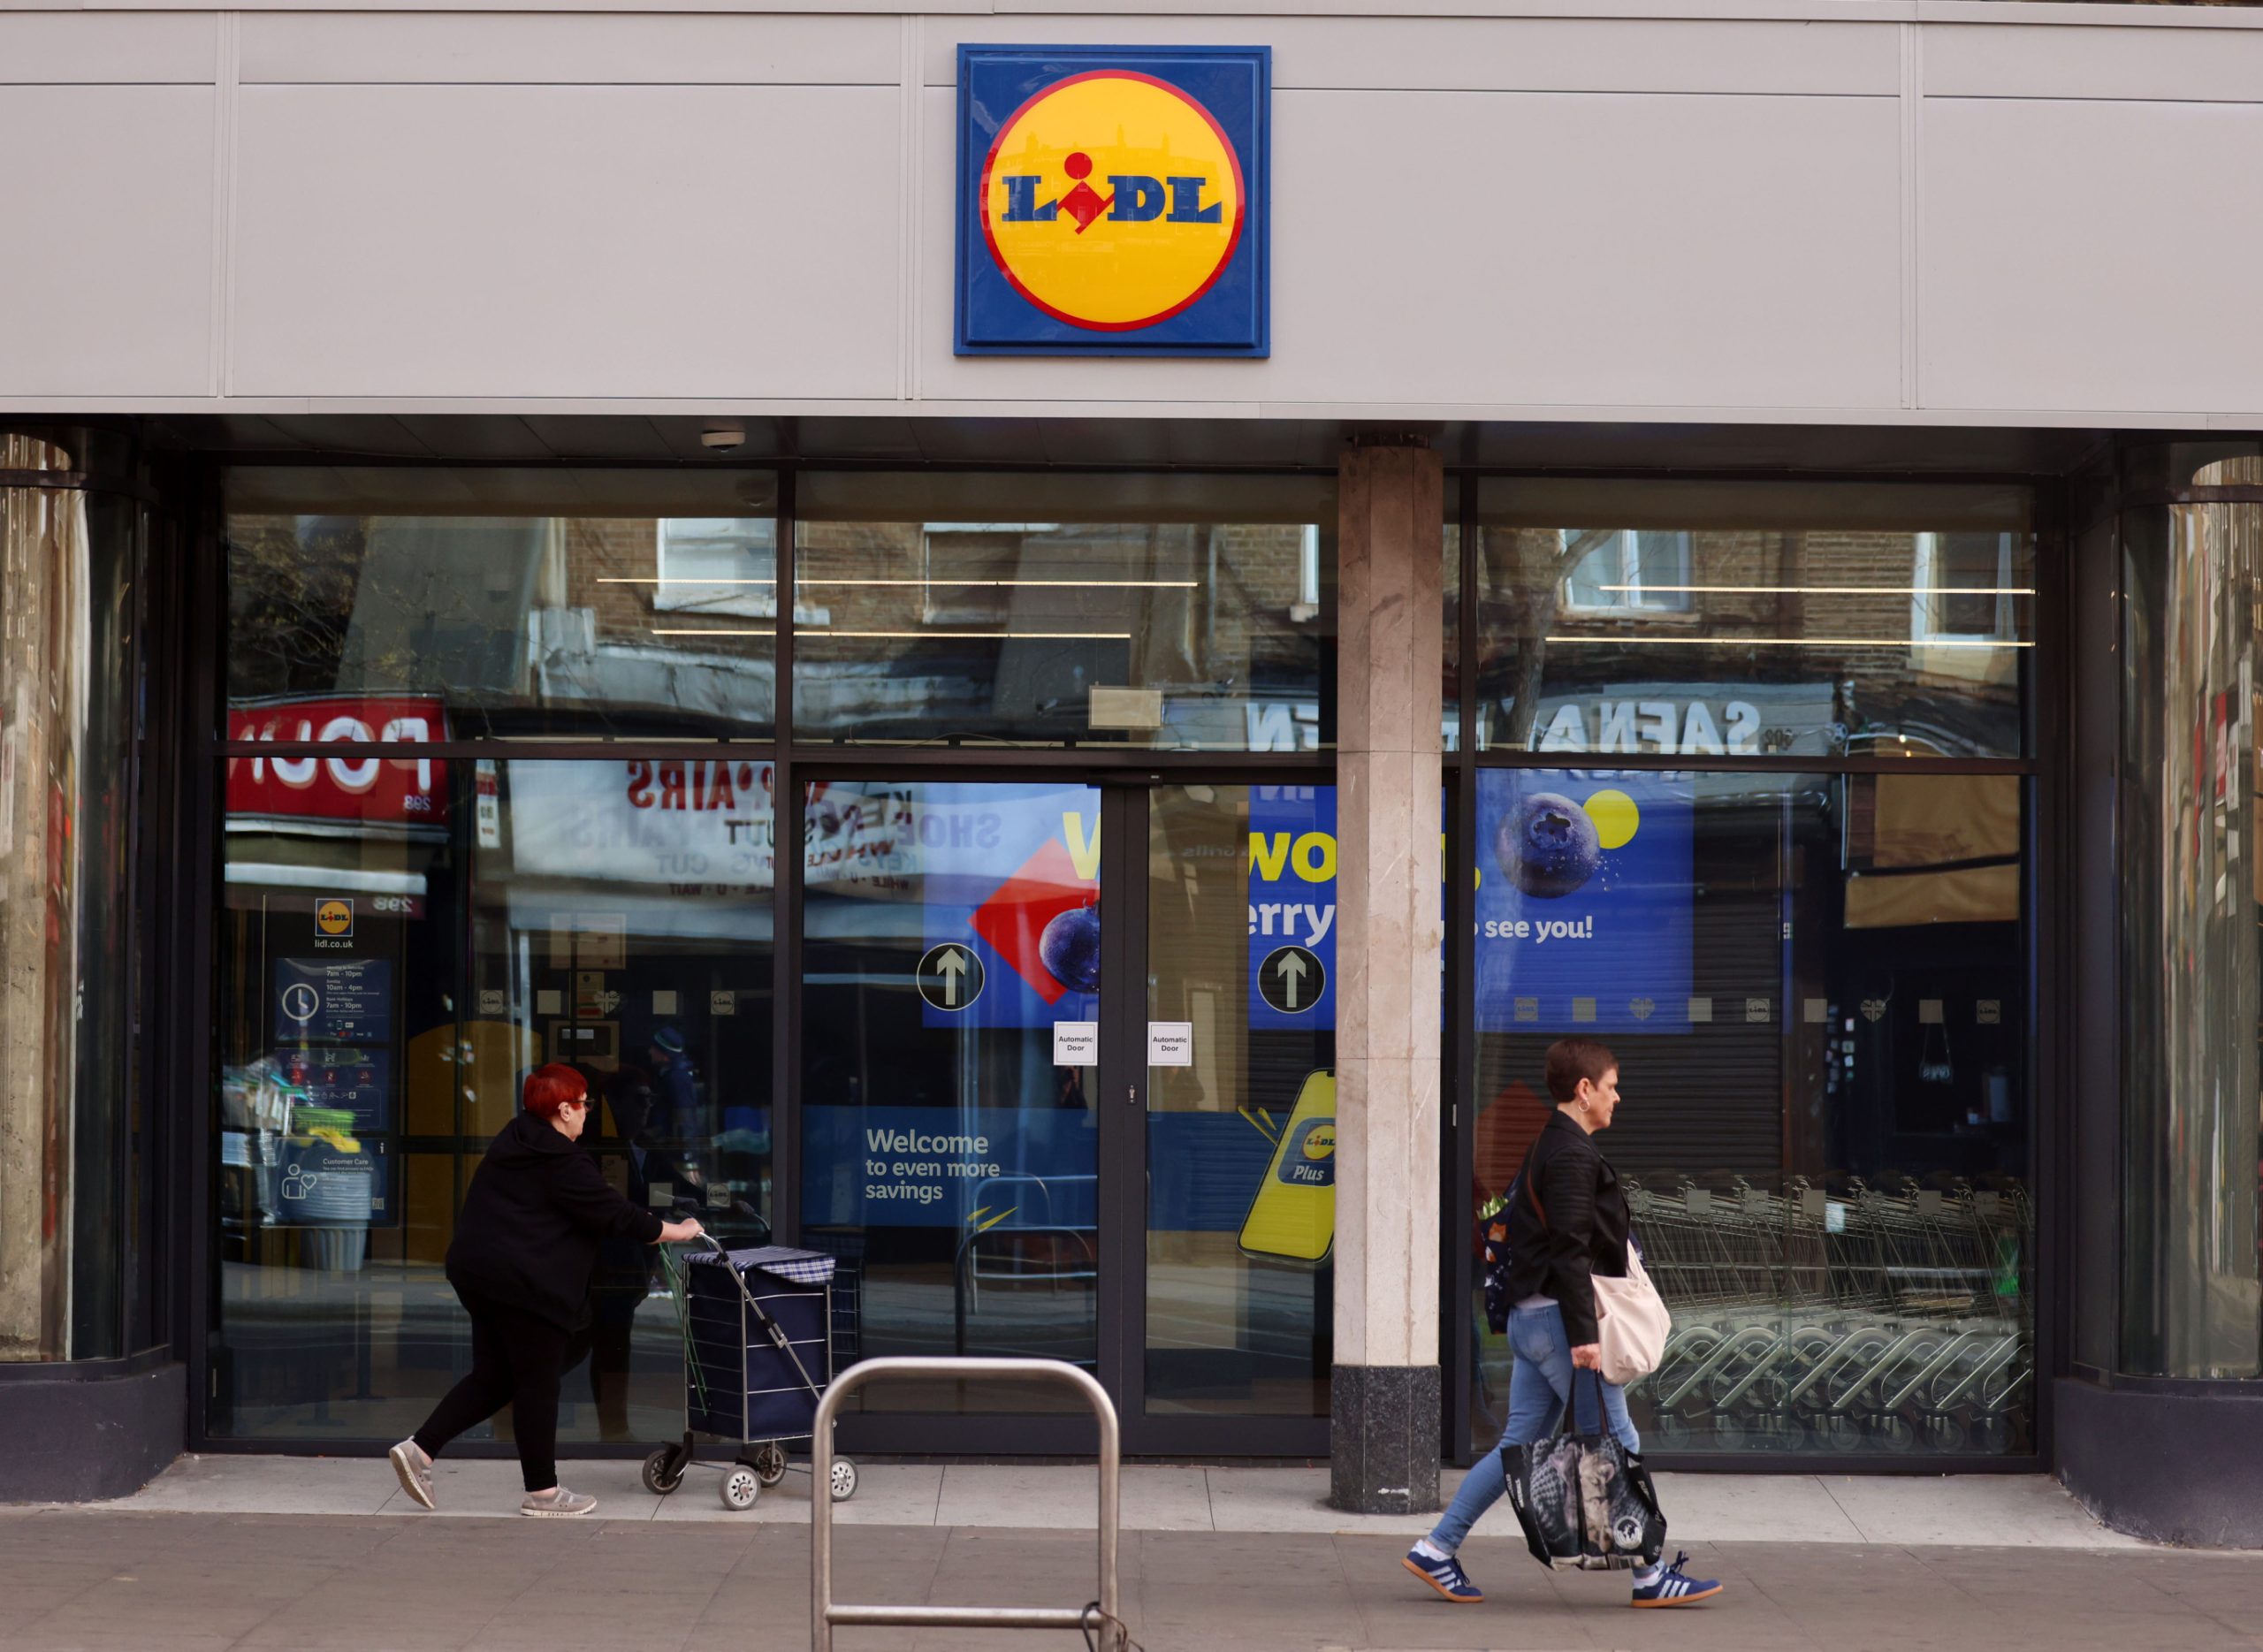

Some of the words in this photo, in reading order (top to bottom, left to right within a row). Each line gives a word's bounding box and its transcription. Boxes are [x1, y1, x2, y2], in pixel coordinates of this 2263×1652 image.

[1002, 152, 1222, 235] LIDL
[1485, 920, 1529, 938] see
[1535, 916, 1593, 944] you!
[315, 940, 353, 948] lidl.co.uk
[866, 1129, 988, 1153] Welcome
[865, 1160, 887, 1176] to
[892, 1161, 941, 1176] even
[947, 1162, 1000, 1177] more
[1292, 1165, 1324, 1180] Plus
[865, 1180, 943, 1204] savings
